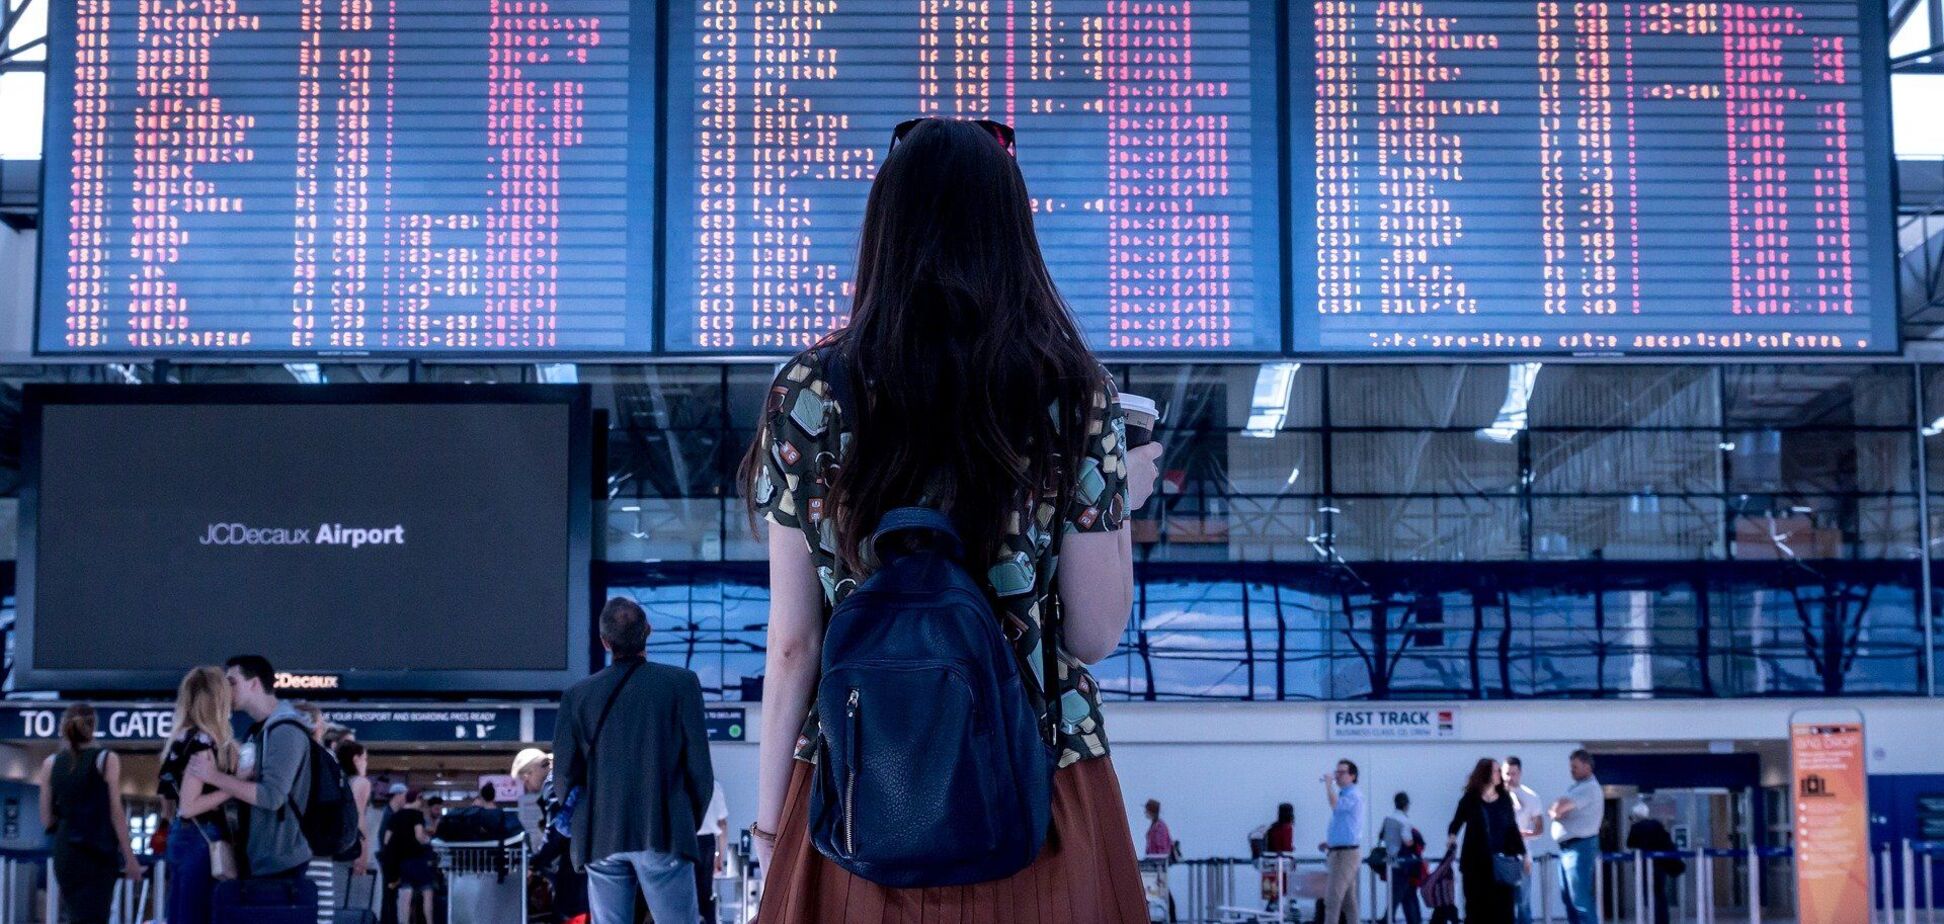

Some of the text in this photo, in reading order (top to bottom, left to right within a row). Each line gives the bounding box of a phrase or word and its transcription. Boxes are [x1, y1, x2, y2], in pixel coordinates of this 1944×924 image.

[199, 523, 405, 549] JCDecaux Airport
[19, 711, 56, 737] TO
[353, 712, 392, 721] PASSPORT
[393, 712, 409, 721] AND
[410, 712, 449, 721] BOARDING
[450, 712, 469, 721] PASS
[470, 712, 497, 721] READY
[1335, 711, 1430, 725] FAST TRACK
